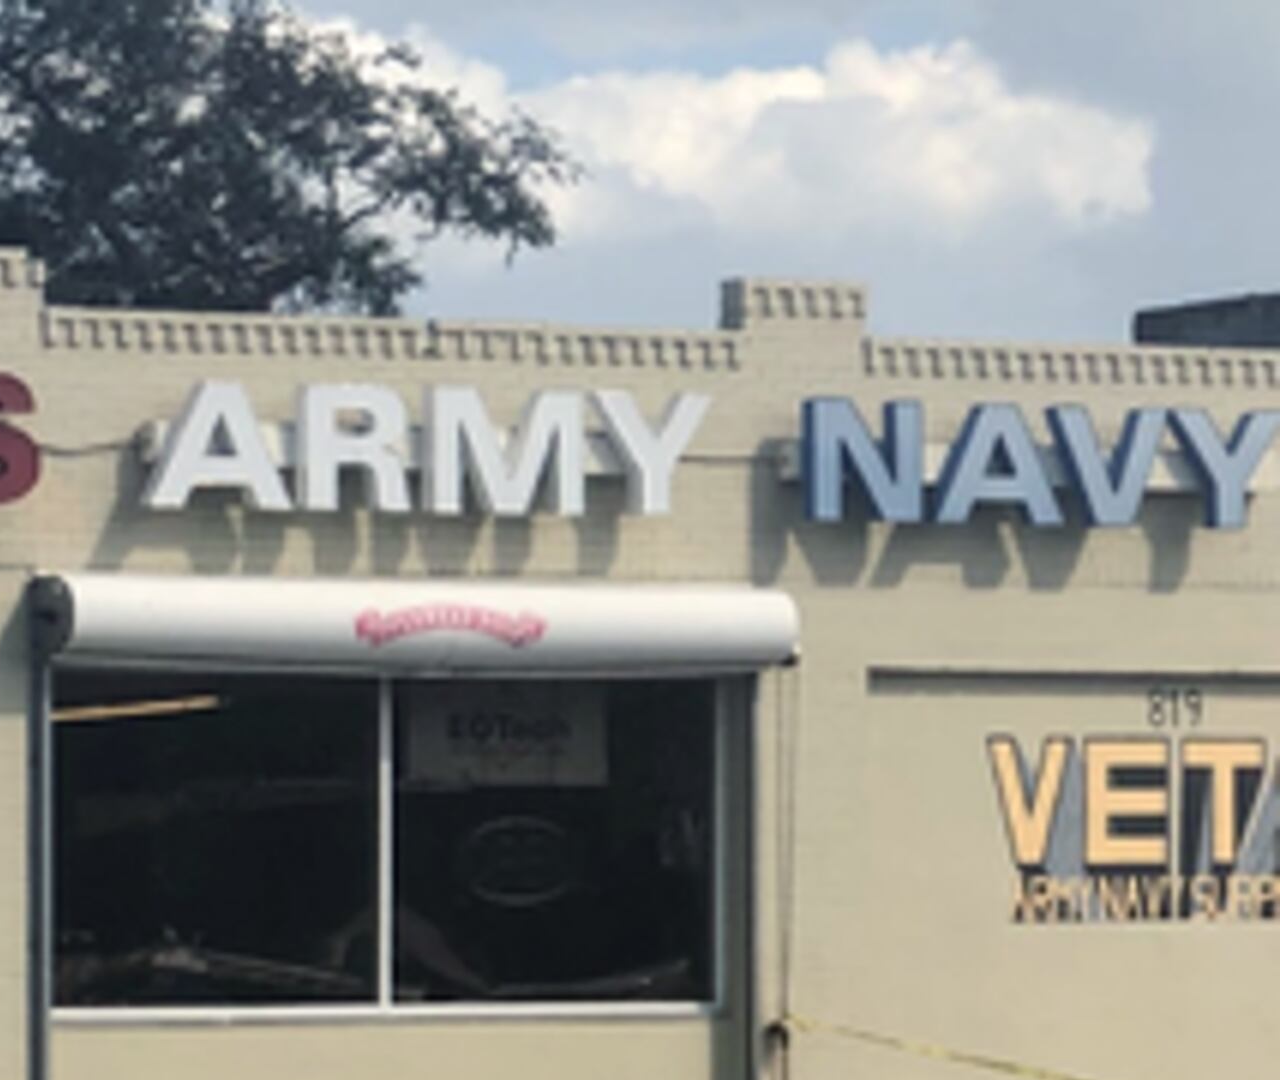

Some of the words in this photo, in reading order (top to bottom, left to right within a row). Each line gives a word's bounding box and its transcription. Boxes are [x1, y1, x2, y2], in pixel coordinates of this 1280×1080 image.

[148, 379, 711, 516] ARMY
[801, 395, 1280, 529] NAVY
[1146, 688, 1203, 727] 819
